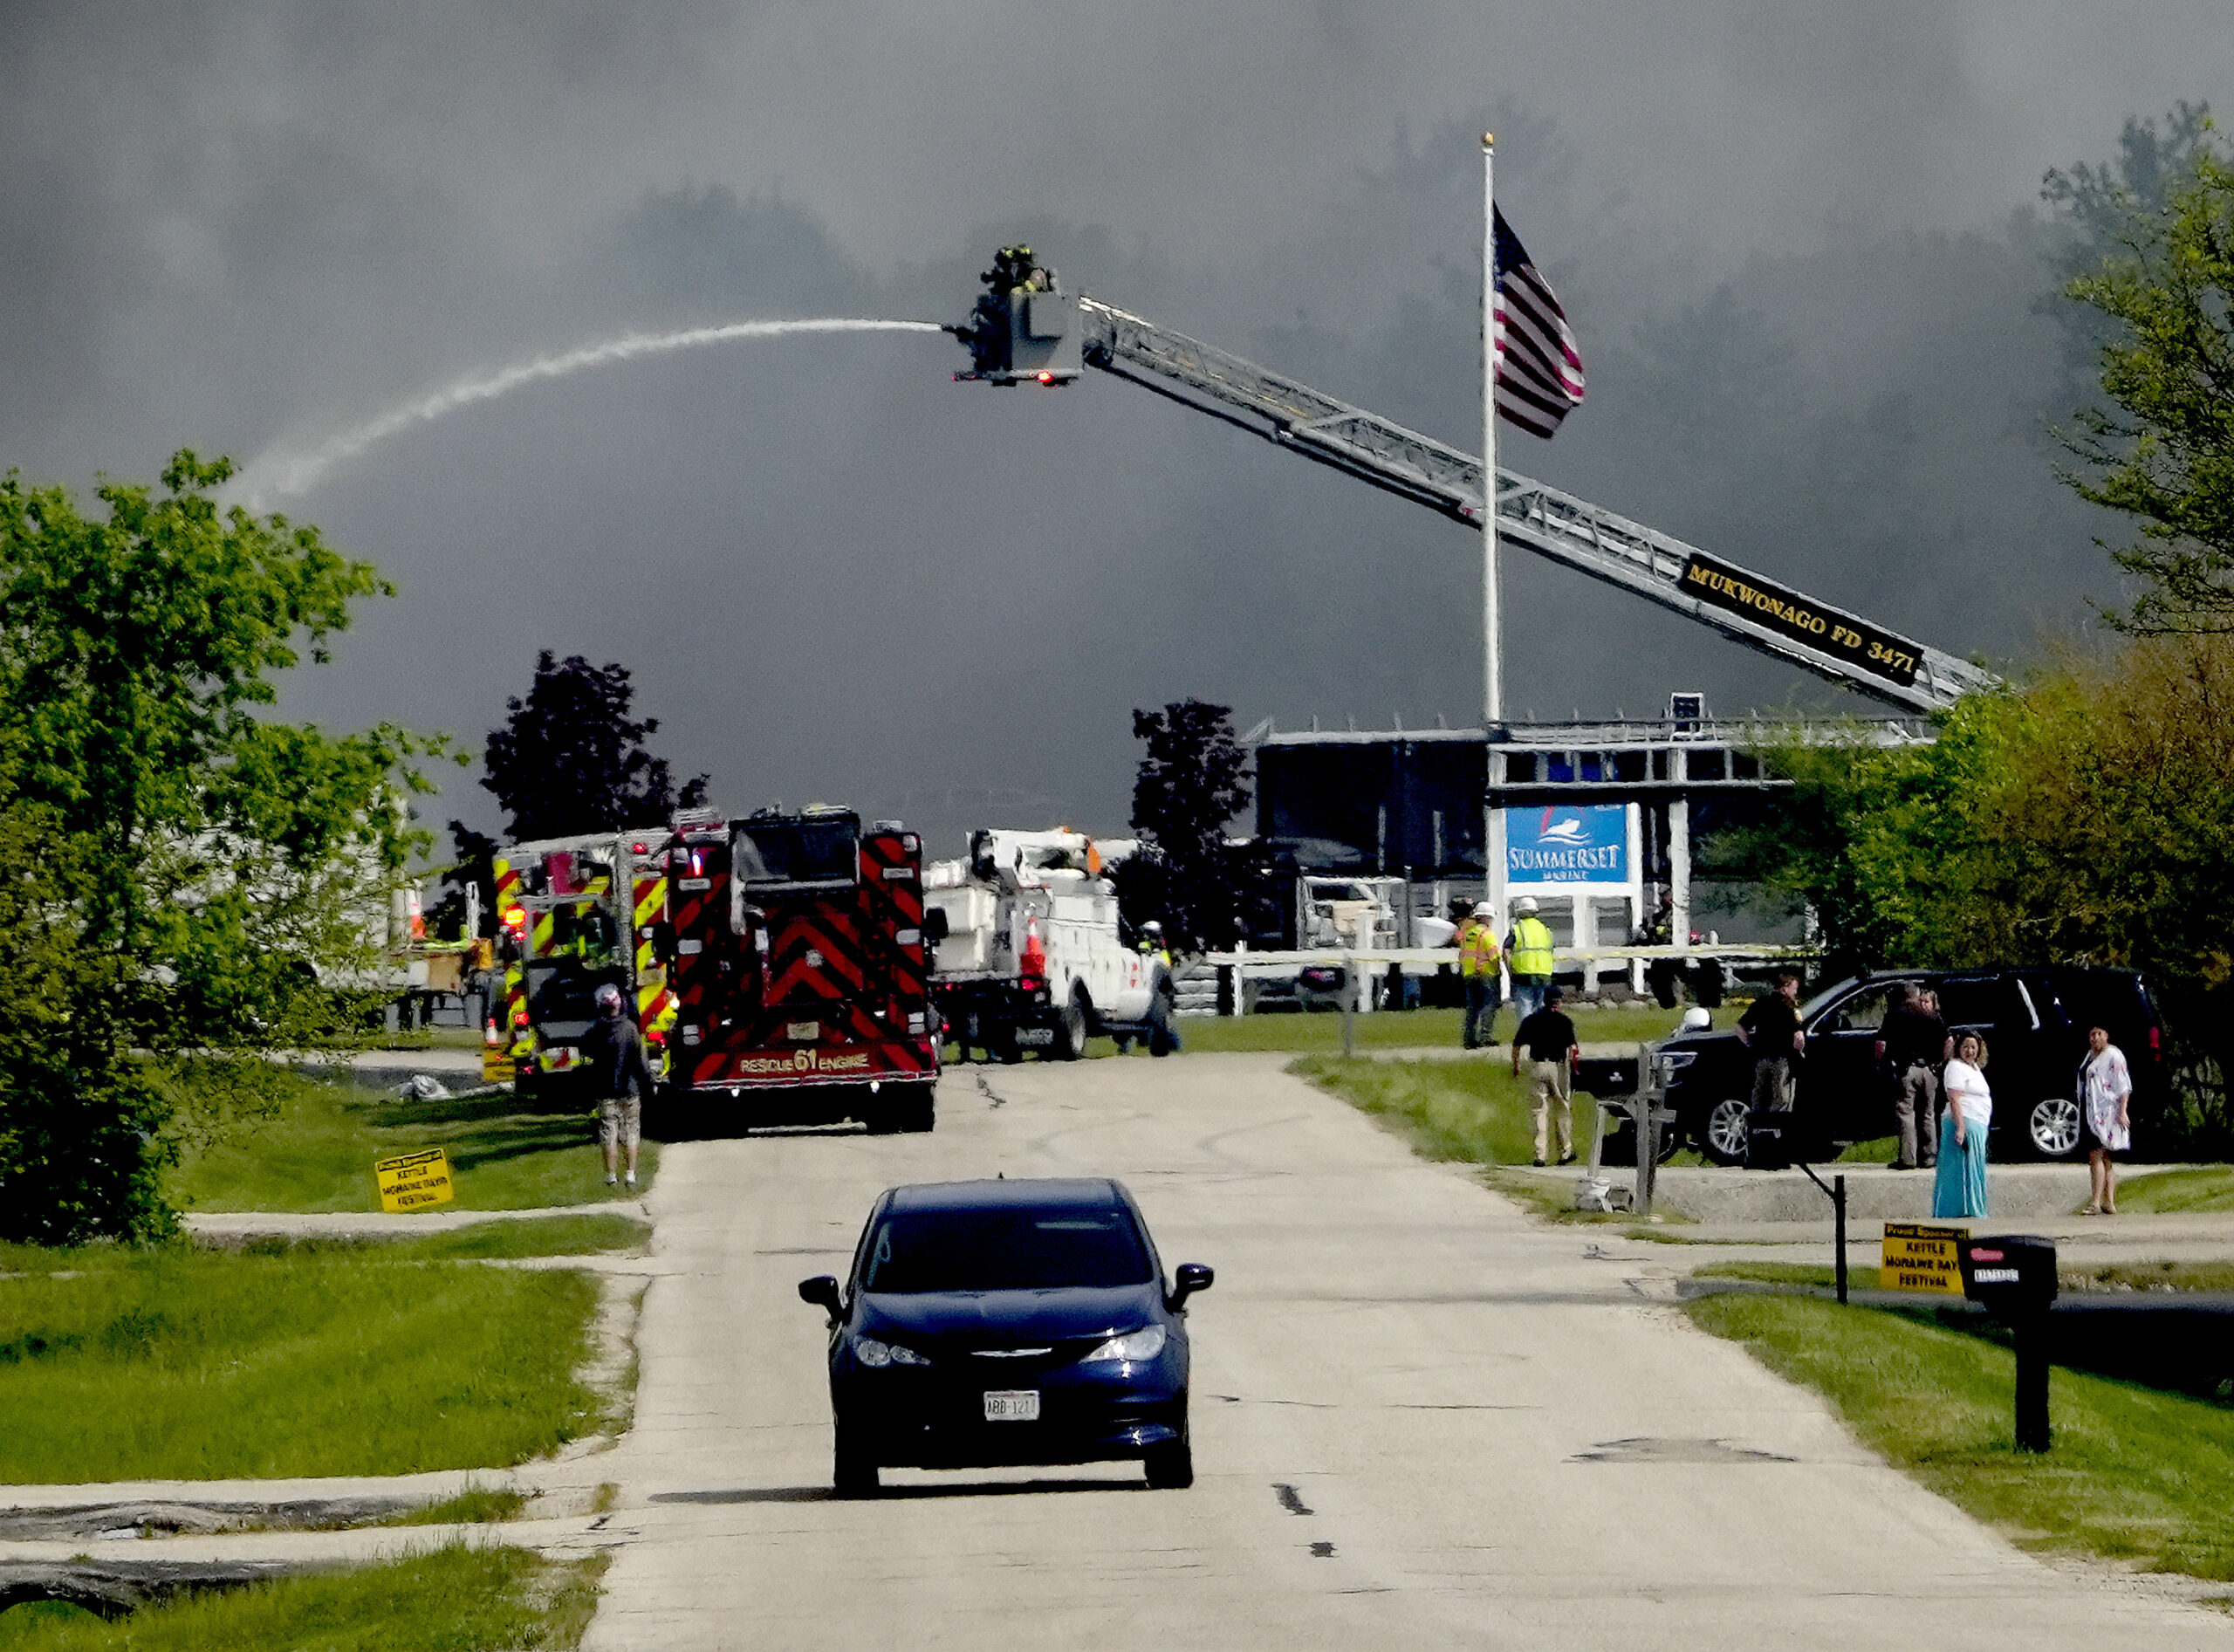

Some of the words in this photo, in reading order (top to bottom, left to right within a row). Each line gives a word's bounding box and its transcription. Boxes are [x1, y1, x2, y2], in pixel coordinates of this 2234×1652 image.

[1688, 564, 1826, 635] MUKWONAGO
[1830, 624, 1862, 649] FD
[1867, 641, 1915, 674] 3471
[1509, 845, 1621, 870] SUMMERSET
[1543, 870, 1590, 881] MARINE
[740, 1057, 793, 1073] RESCUE
[793, 1048, 817, 1071] 61
[819, 1052, 870, 1071] ENGINE
[1906, 1241, 1946, 1256] KETTLE
[1899, 1272, 1948, 1287] FESTIVAL
